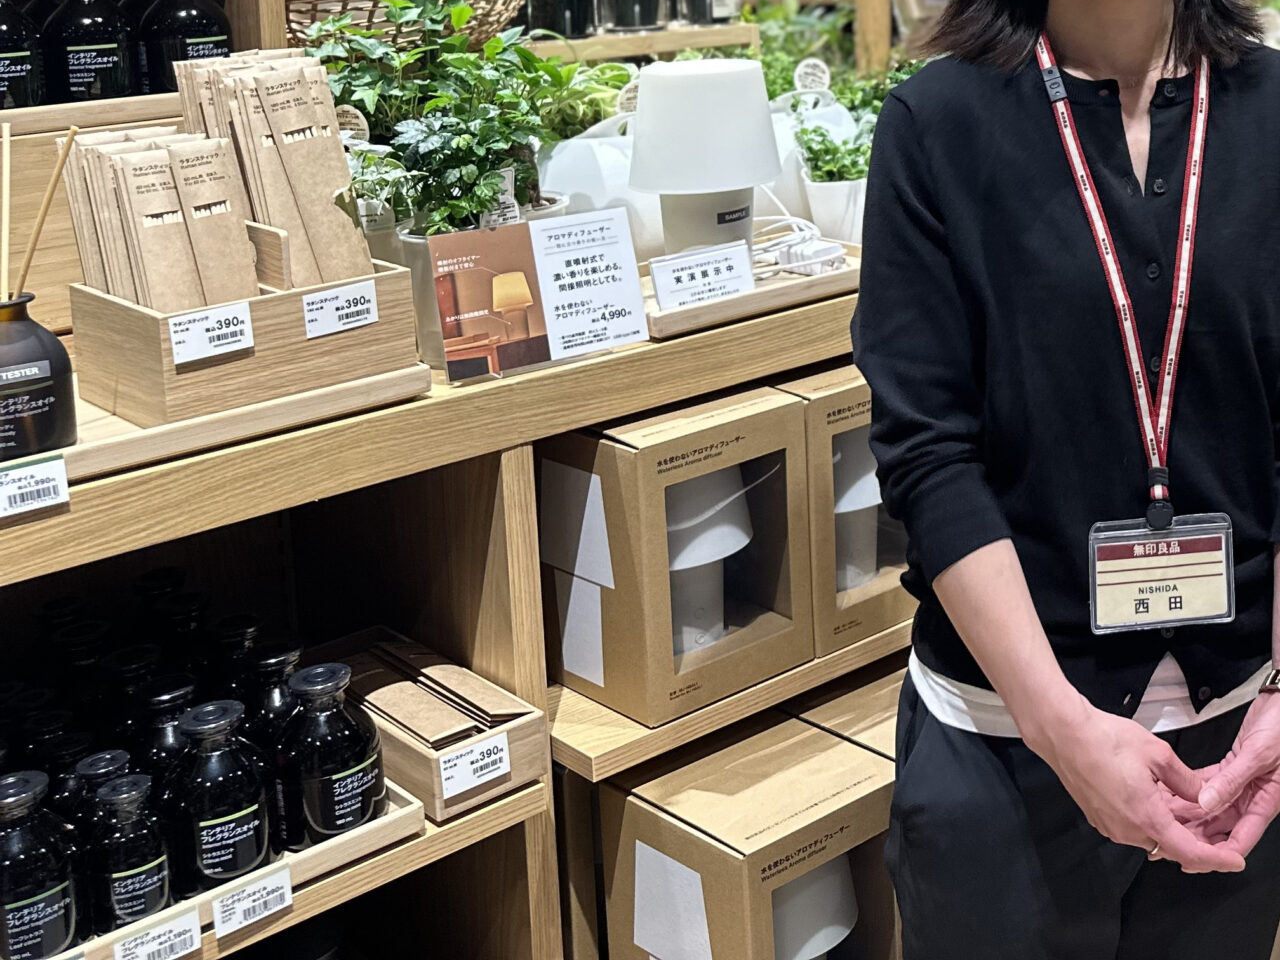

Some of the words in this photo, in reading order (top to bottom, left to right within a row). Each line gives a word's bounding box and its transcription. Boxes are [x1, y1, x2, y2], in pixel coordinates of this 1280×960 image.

[68, 56, 118, 64] フレグランスオイル
[265, 80, 301, 91] ラタンスティック
[179, 152, 219, 164] ラタンスティック
[725, 211, 746, 220] SAMPLE
[547, 226, 611, 241] アロマディフューザー
[565, 254, 604, 268] 直噴射式で
[553, 263, 622, 282] 濃い香りを楽しめる。
[674, 264, 734, 285] 実演展示中
[559, 275, 622, 292] 間接照明としても。
[306, 296, 339, 307] ラタンスティック
[554, 299, 592, 312] 水を使わない
[555, 303, 615, 319] アロマディフューザー
[173, 316, 209, 327] ラタンスティック
[2, 367, 39, 380] TESTER
[657, 435, 747, 468] 水を使わないアロマディフューザー
[657, 462, 684, 475] Waterless
[684, 457, 702, 467] Aroma
[703, 451, 723, 461] diffuser
[1133, 541, 1181, 556] 無印良品
[1138, 584, 1179, 595] NISHIDA
[443, 749, 474, 765] ラタンスティック
[333, 772, 363, 788] インテリア
[333, 768, 378, 795] フレグランスオイル
[200, 823, 236, 836] インテリア
[201, 820, 260, 843] フレグランスオイル
[761, 825, 850, 875] 水を使わないアロマディフューザー
[761, 866, 788, 882] Waterless
[789, 856, 806, 869] Aroma
[807, 845, 827, 858] diffuser
[113, 874, 146, 887] インテリア
[6, 902, 45, 919] インテリア
[6, 897, 71, 927] フレグランスオイル
